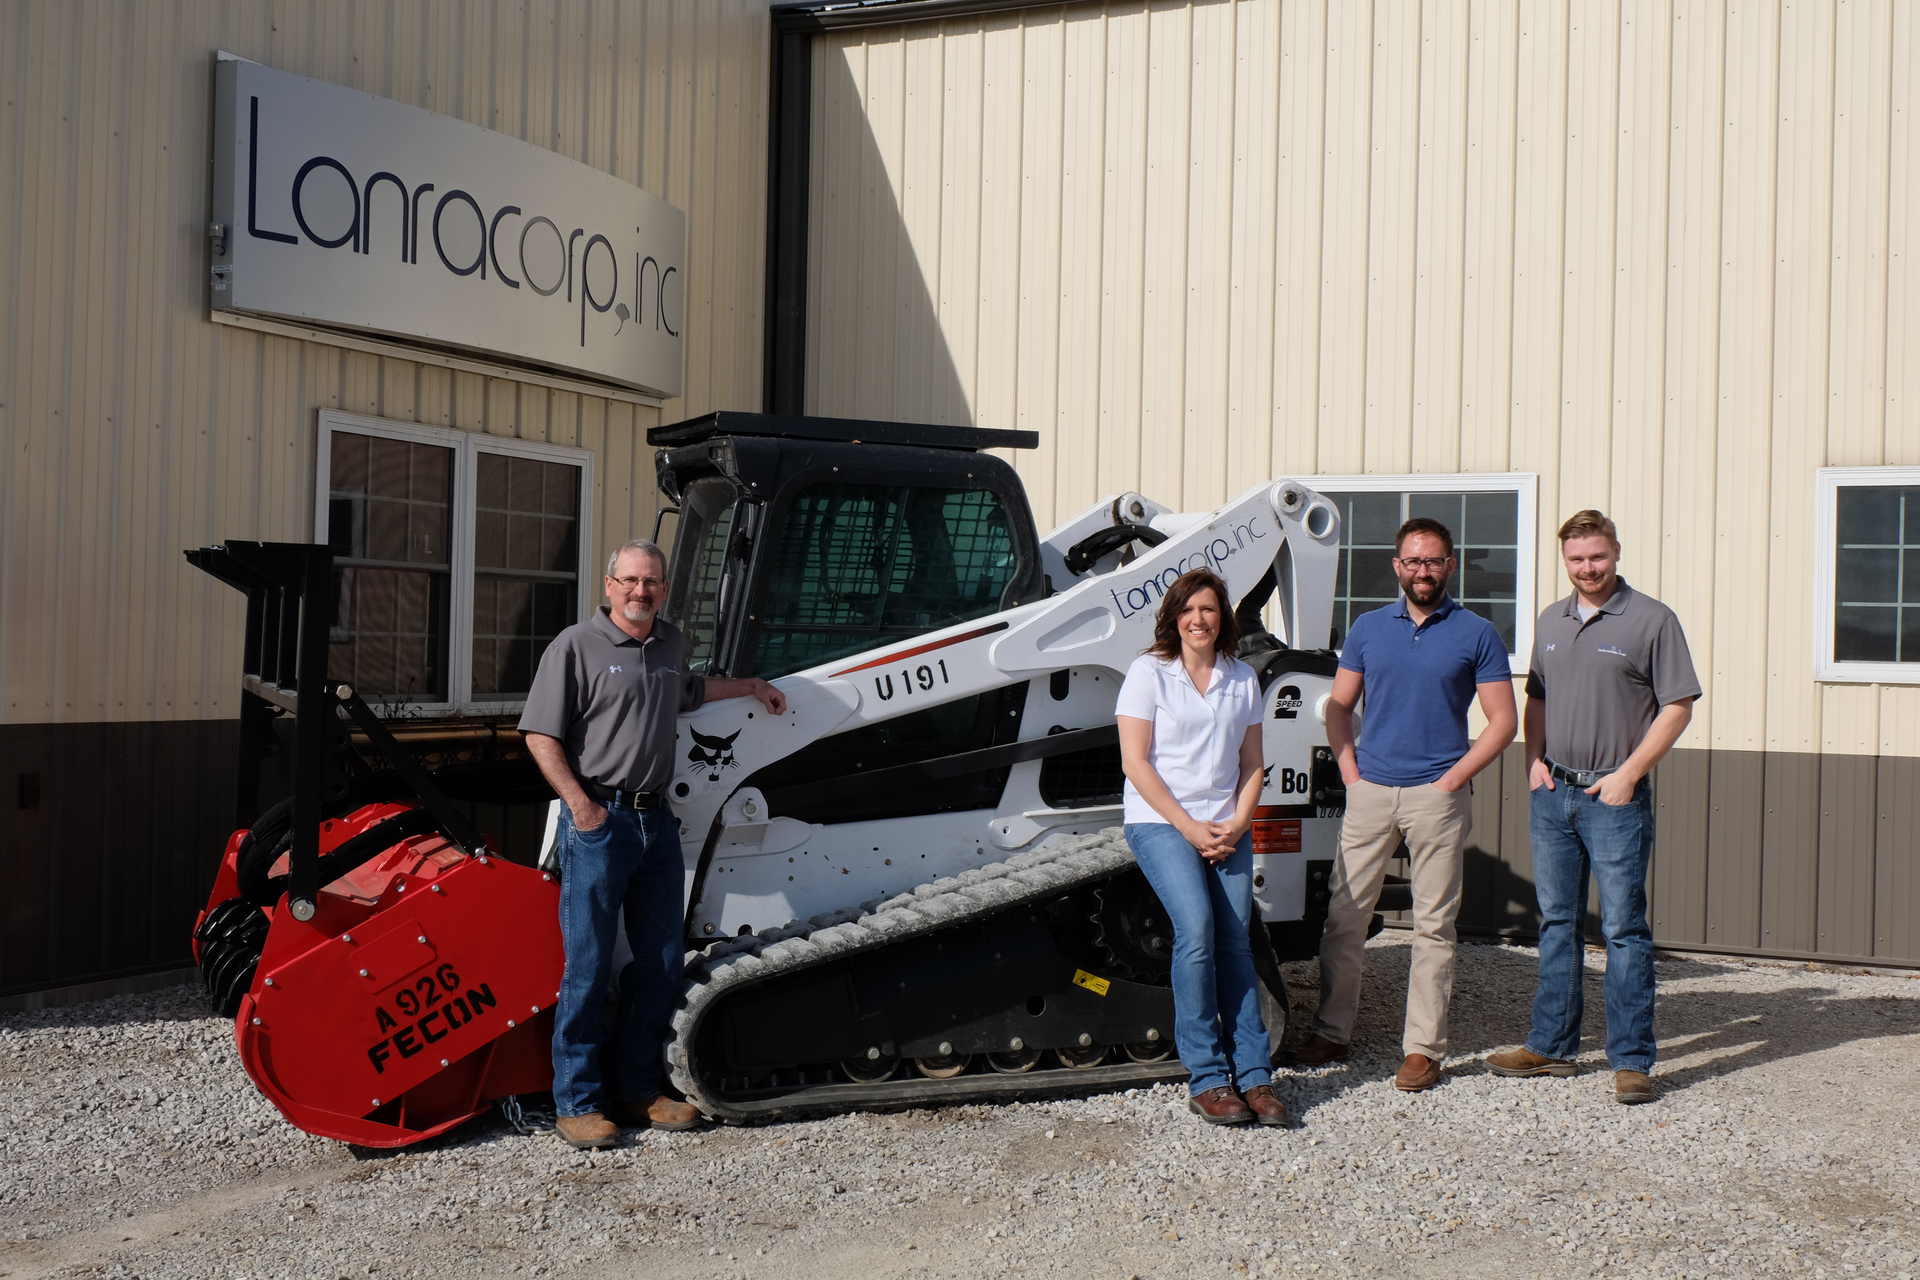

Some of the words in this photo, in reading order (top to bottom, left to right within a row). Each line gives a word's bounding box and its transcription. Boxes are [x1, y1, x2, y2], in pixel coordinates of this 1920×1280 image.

[1276, 700, 1303, 708] SPEED
[1281, 767, 1308, 794] Bo
[367, 982, 497, 1075] FECON
